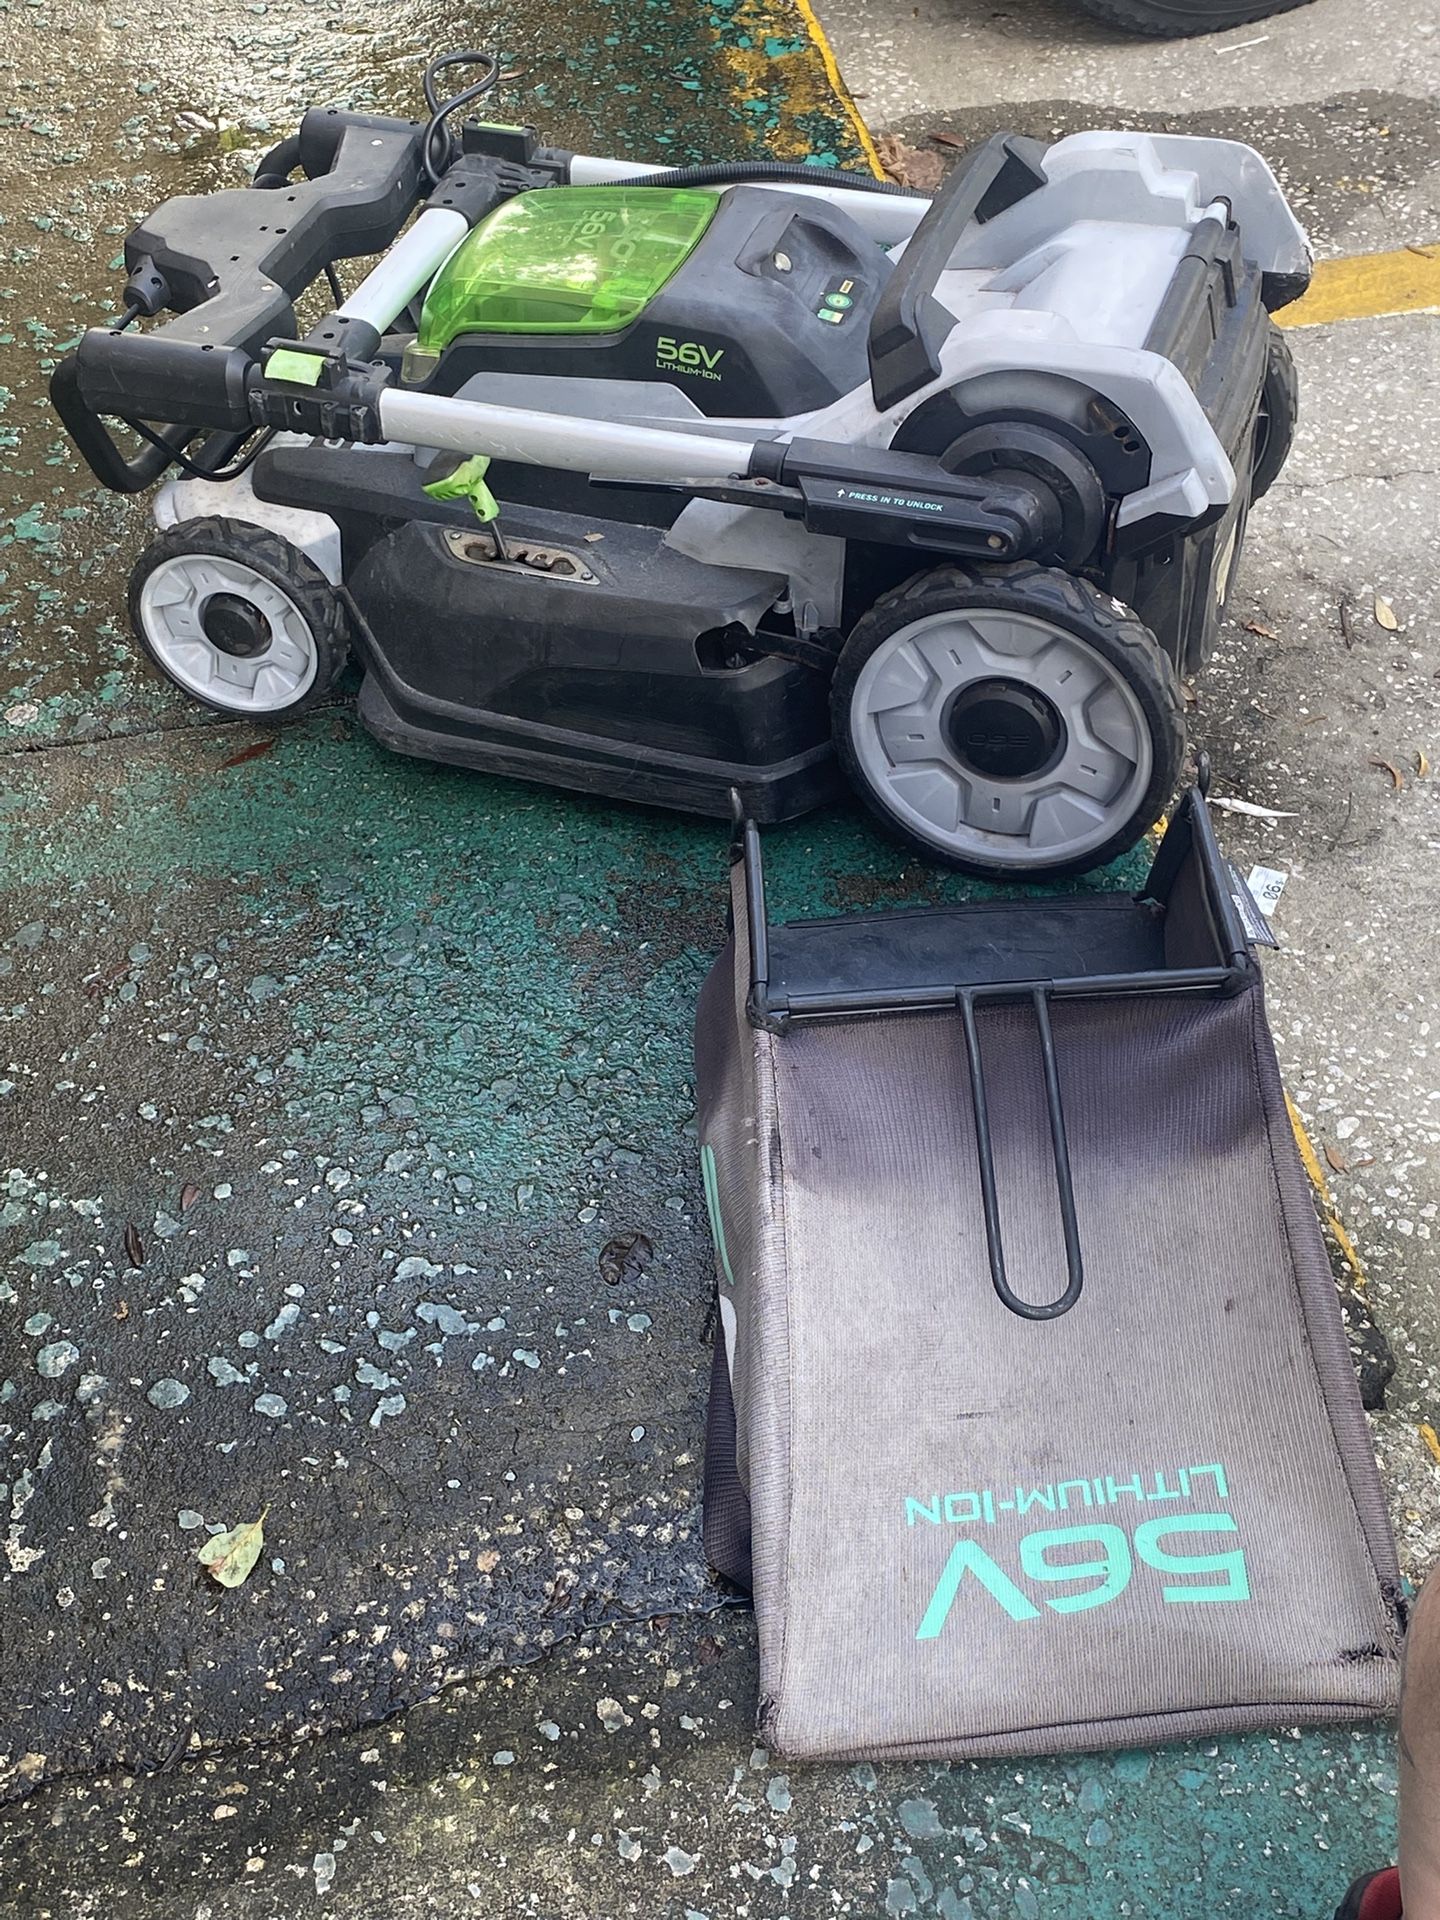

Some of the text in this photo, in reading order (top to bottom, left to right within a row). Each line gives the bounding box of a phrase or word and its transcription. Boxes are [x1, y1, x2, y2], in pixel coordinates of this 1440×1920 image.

[574, 209, 618, 249] 56V
[656, 359, 722, 381] LITHIUM-ION
[657, 336, 724, 369] 56V
[848, 491, 944, 512] PRESS IN TO UNLOCK
[905, 1462, 1229, 1526] LITHIUM-ION
[915, 1512, 1251, 1640] 56V
